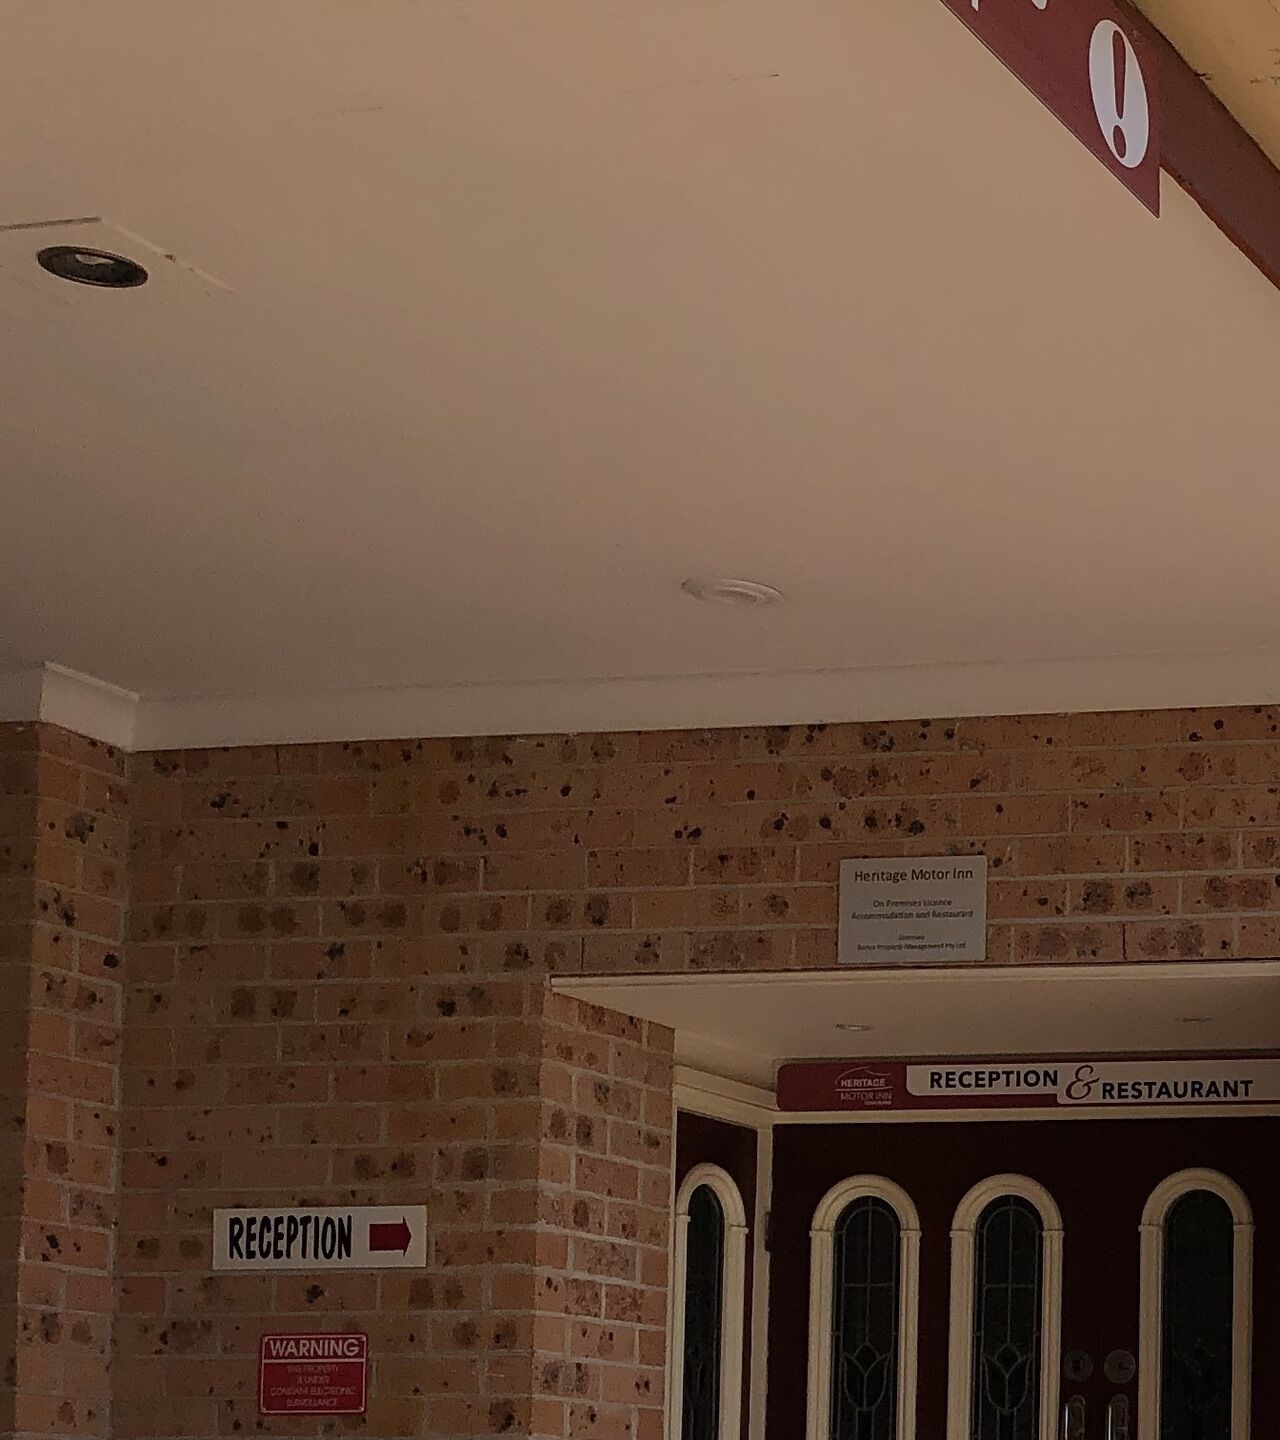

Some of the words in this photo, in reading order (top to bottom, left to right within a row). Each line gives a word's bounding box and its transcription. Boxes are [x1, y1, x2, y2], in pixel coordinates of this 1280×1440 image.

[854, 870, 908, 884] Heritage
[911, 868, 950, 881] Motor
[953, 867, 974, 879] Inn
[873, 899, 885, 908] On
[840, 1078, 887, 1088] HERITAGE
[929, 1069, 1059, 1090] RECEPTION
[1065, 1065, 1100, 1101] &
[1101, 1079, 1254, 1101] RESTAURANT
[840, 1091, 874, 1101] MOTOR
[875, 1090, 893, 1100] INN
[229, 1214, 353, 1260] RECEPTION
[269, 1338, 360, 1357] WARNING
